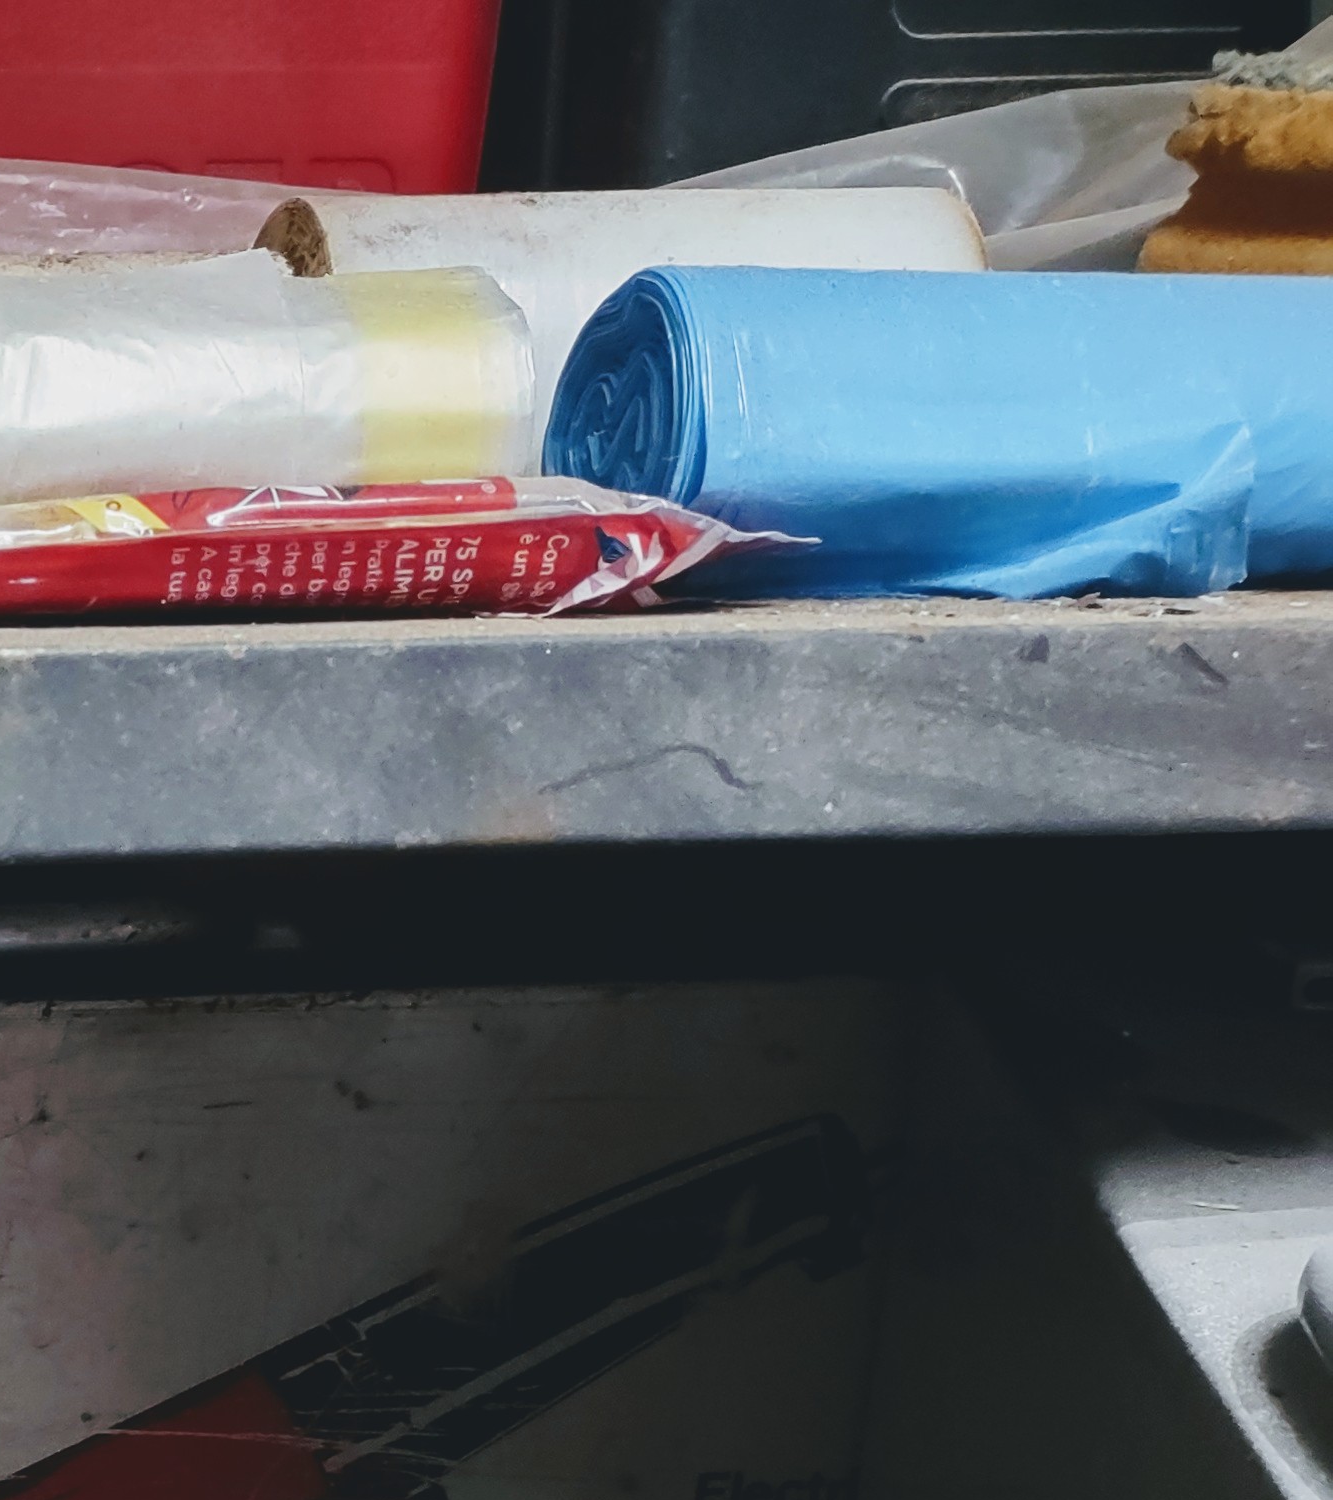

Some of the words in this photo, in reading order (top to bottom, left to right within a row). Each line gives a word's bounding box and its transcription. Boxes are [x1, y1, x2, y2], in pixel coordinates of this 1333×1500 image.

[171, 546, 191, 565] la
[200, 546, 219, 562] A
[423, 537, 452, 583] PER
[511, 549, 530, 577] un
[539, 533, 571, 577] Con
